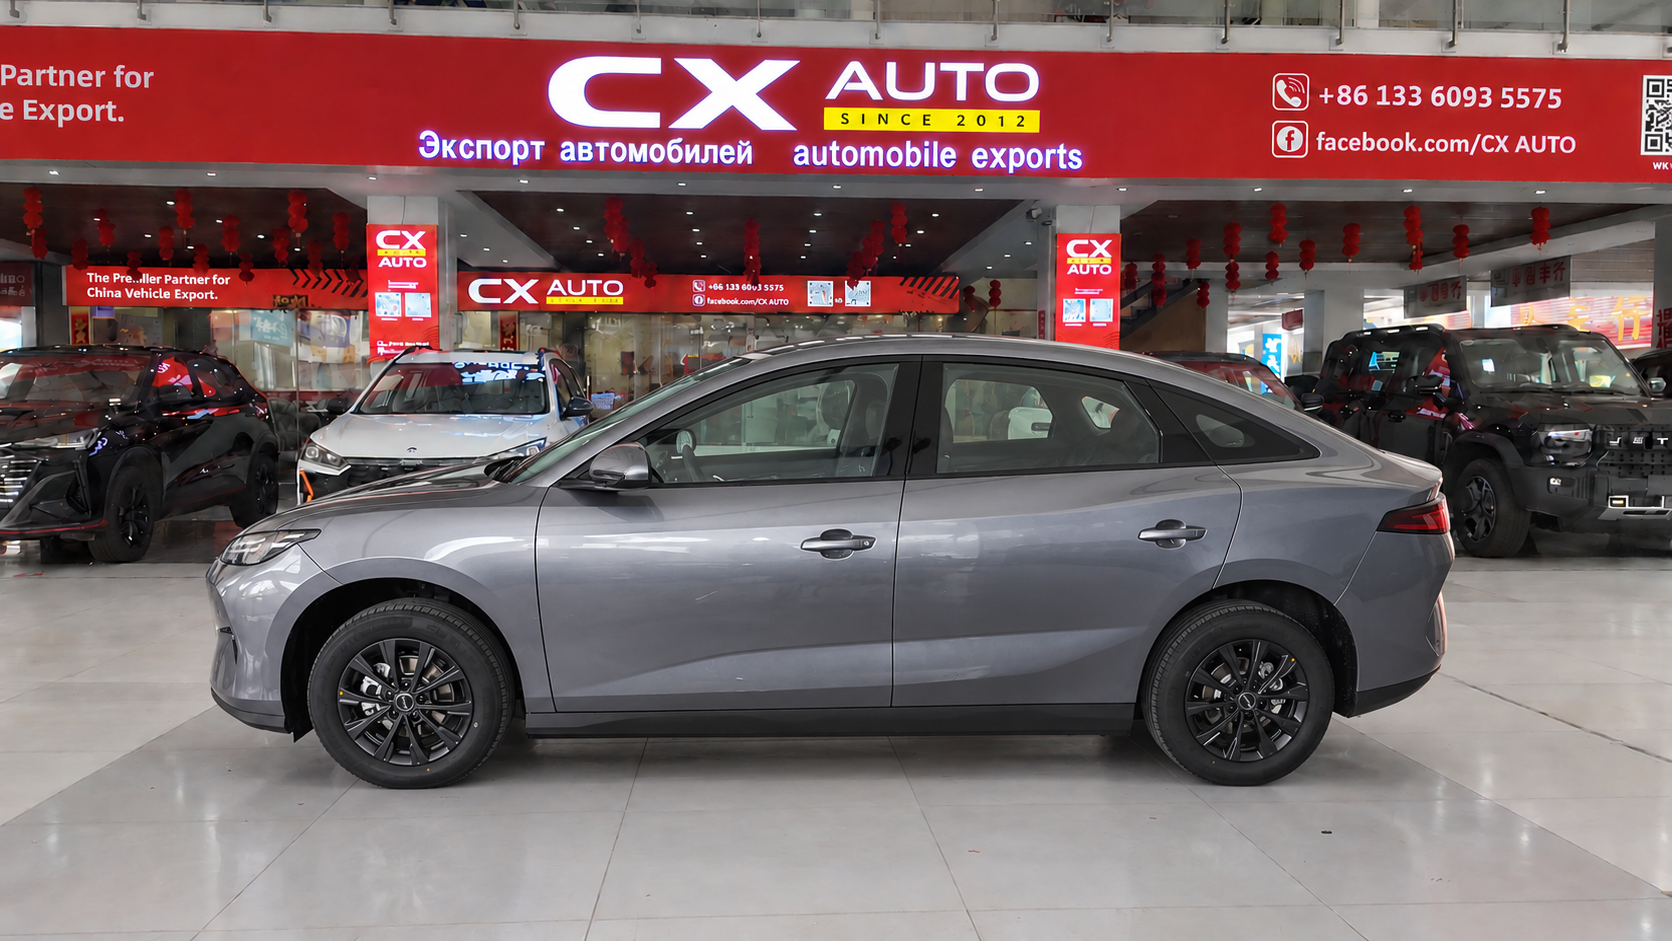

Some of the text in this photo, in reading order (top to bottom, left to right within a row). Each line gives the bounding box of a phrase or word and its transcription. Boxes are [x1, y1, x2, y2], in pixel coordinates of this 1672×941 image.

[0, 64, 155, 89] Partner for
[547, 55, 1040, 131] CX AUTO
[1318, 84, 1562, 109] +86 133 6093 5575
[23, 99, 125, 128] Export.
[840, 112, 1025, 128] SINCE 2012
[418, 129, 754, 166] Экспорт автомобилей
[1315, 131, 1576, 156] facebook.com/CX AUTO
[793, 140, 1083, 174] automobile exports
[375, 229, 426, 250] CX
[1066, 239, 1113, 258] CX
[378, 256, 427, 268] AUTO
[1066, 263, 1112, 275] AUTO
[86, 272, 110, 284] The
[164, 274, 211, 285] Partner
[212, 273, 231, 285] for
[725, 283, 740, 291] 133
[86, 286, 219, 302] China Vehicle Export.
[467, 278, 624, 304] CX AUTO
